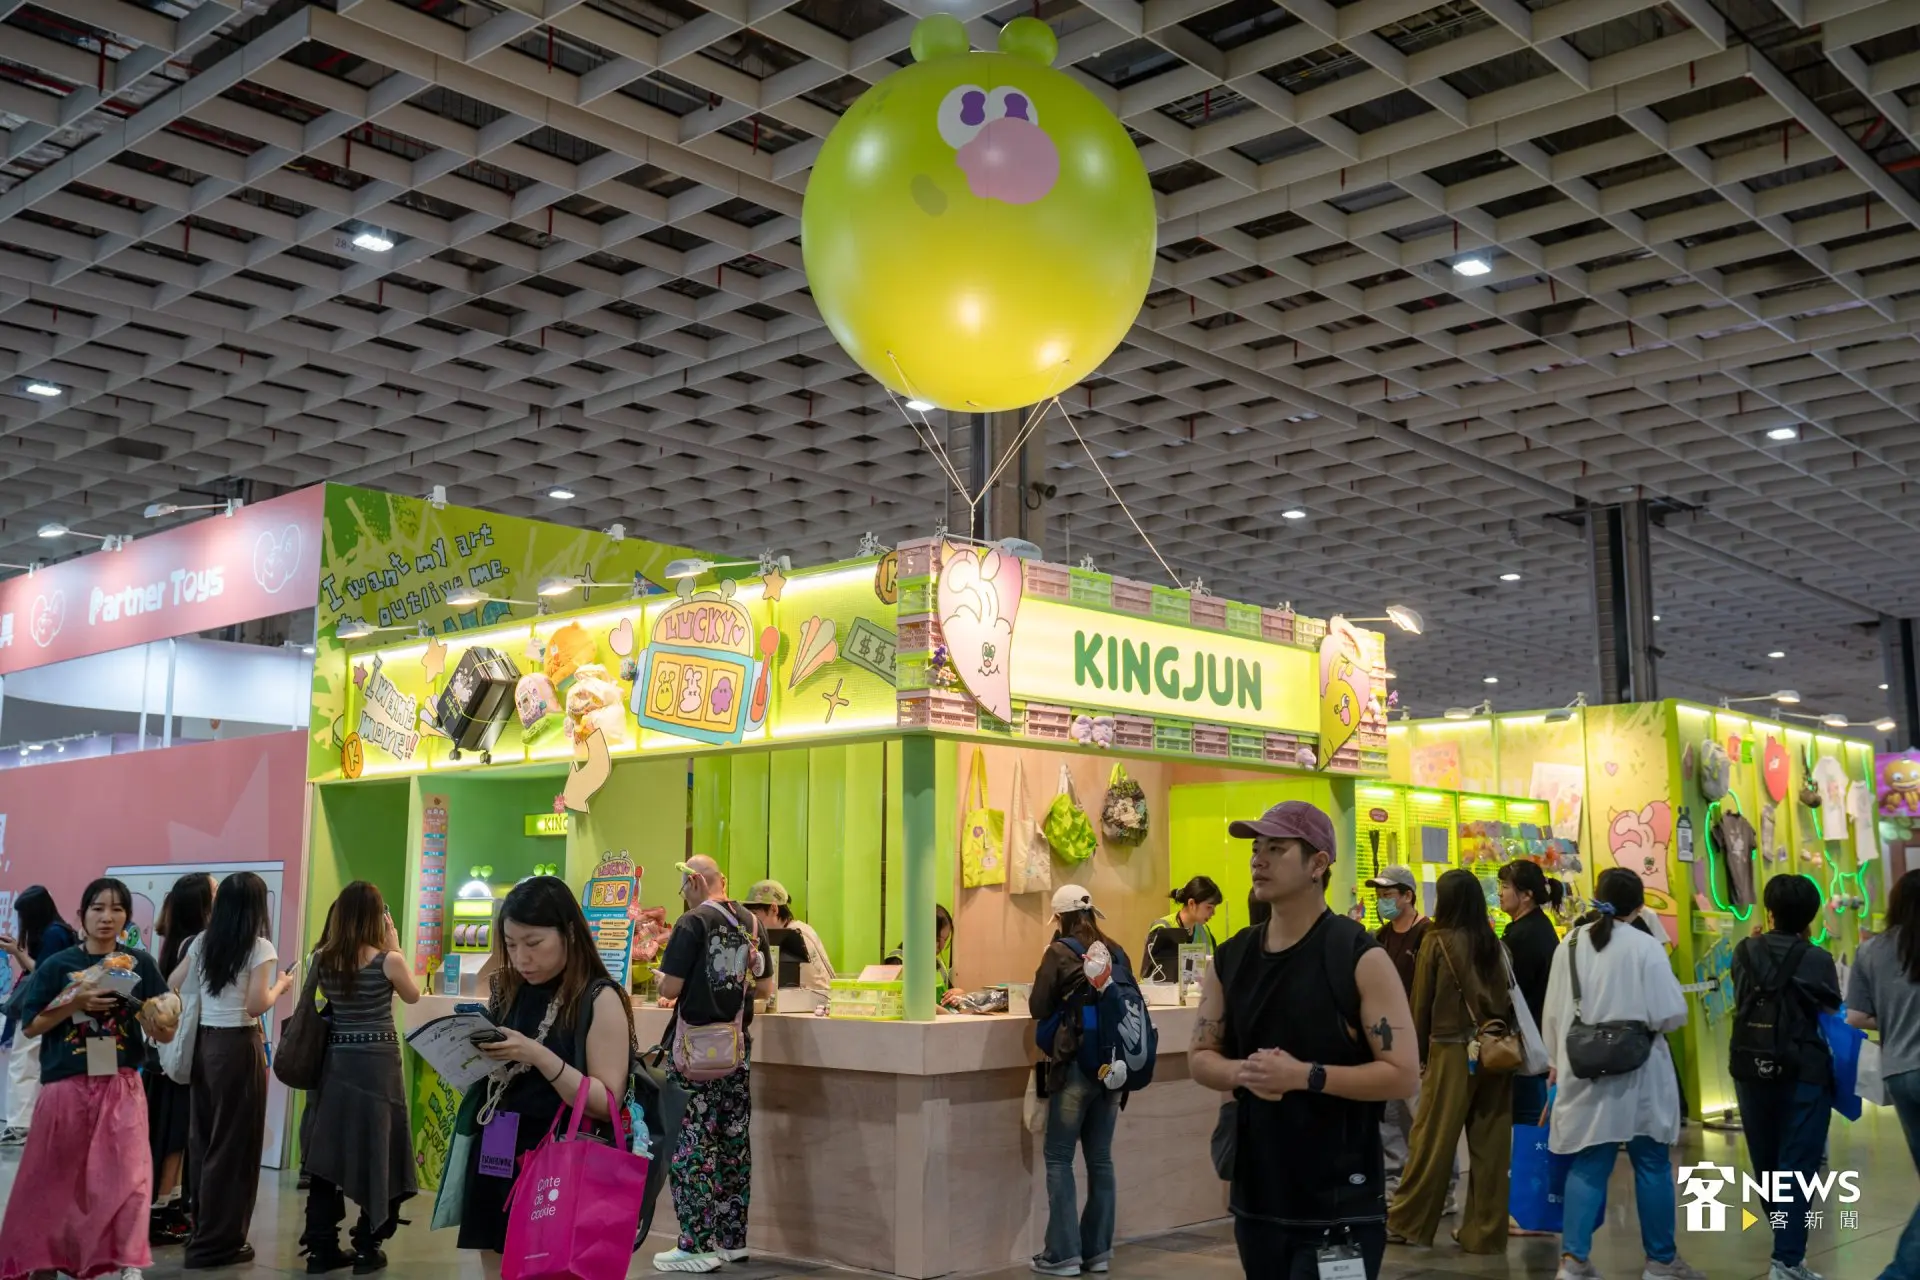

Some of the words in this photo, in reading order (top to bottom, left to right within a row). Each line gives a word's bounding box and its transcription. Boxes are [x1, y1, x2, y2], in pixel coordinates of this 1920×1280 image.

[89, 581, 166, 625] Partner
[170, 566, 225, 607] Toys
[322, 572, 344, 612] I
[347, 552, 411, 600] want
[416, 538, 447, 573] my
[455, 523, 494, 557] art
[468, 559, 510, 588] me.
[665, 606, 737, 646] LUCKY
[364, 653, 382, 699] I
[375, 675, 416, 731] want
[1074, 630, 1263, 711] KINGJUN
